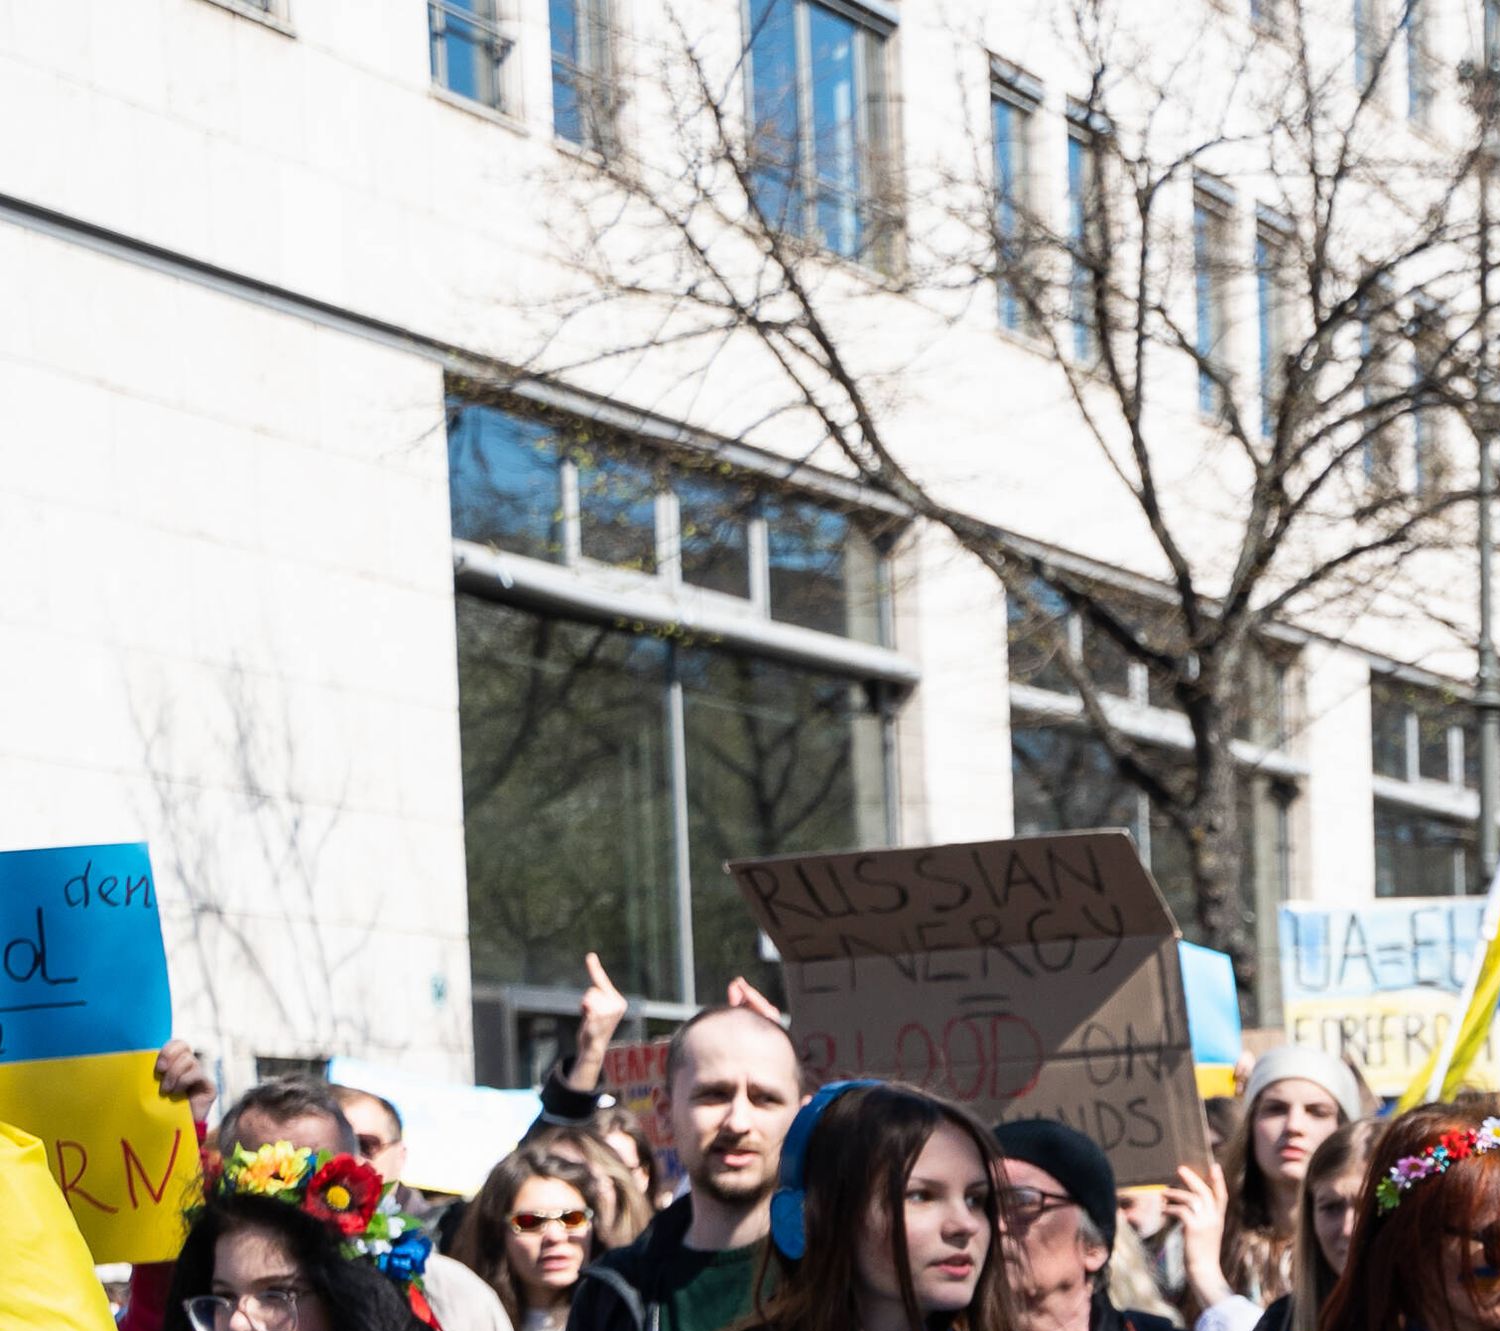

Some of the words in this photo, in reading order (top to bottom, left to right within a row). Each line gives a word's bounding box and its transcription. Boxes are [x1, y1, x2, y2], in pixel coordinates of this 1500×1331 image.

[739, 843, 1106, 929] RUSSIAN
[786, 904, 1124, 993] ENERGY
[1081, 1022, 1162, 1087] ON
[55, 1127, 182, 1215] RN
